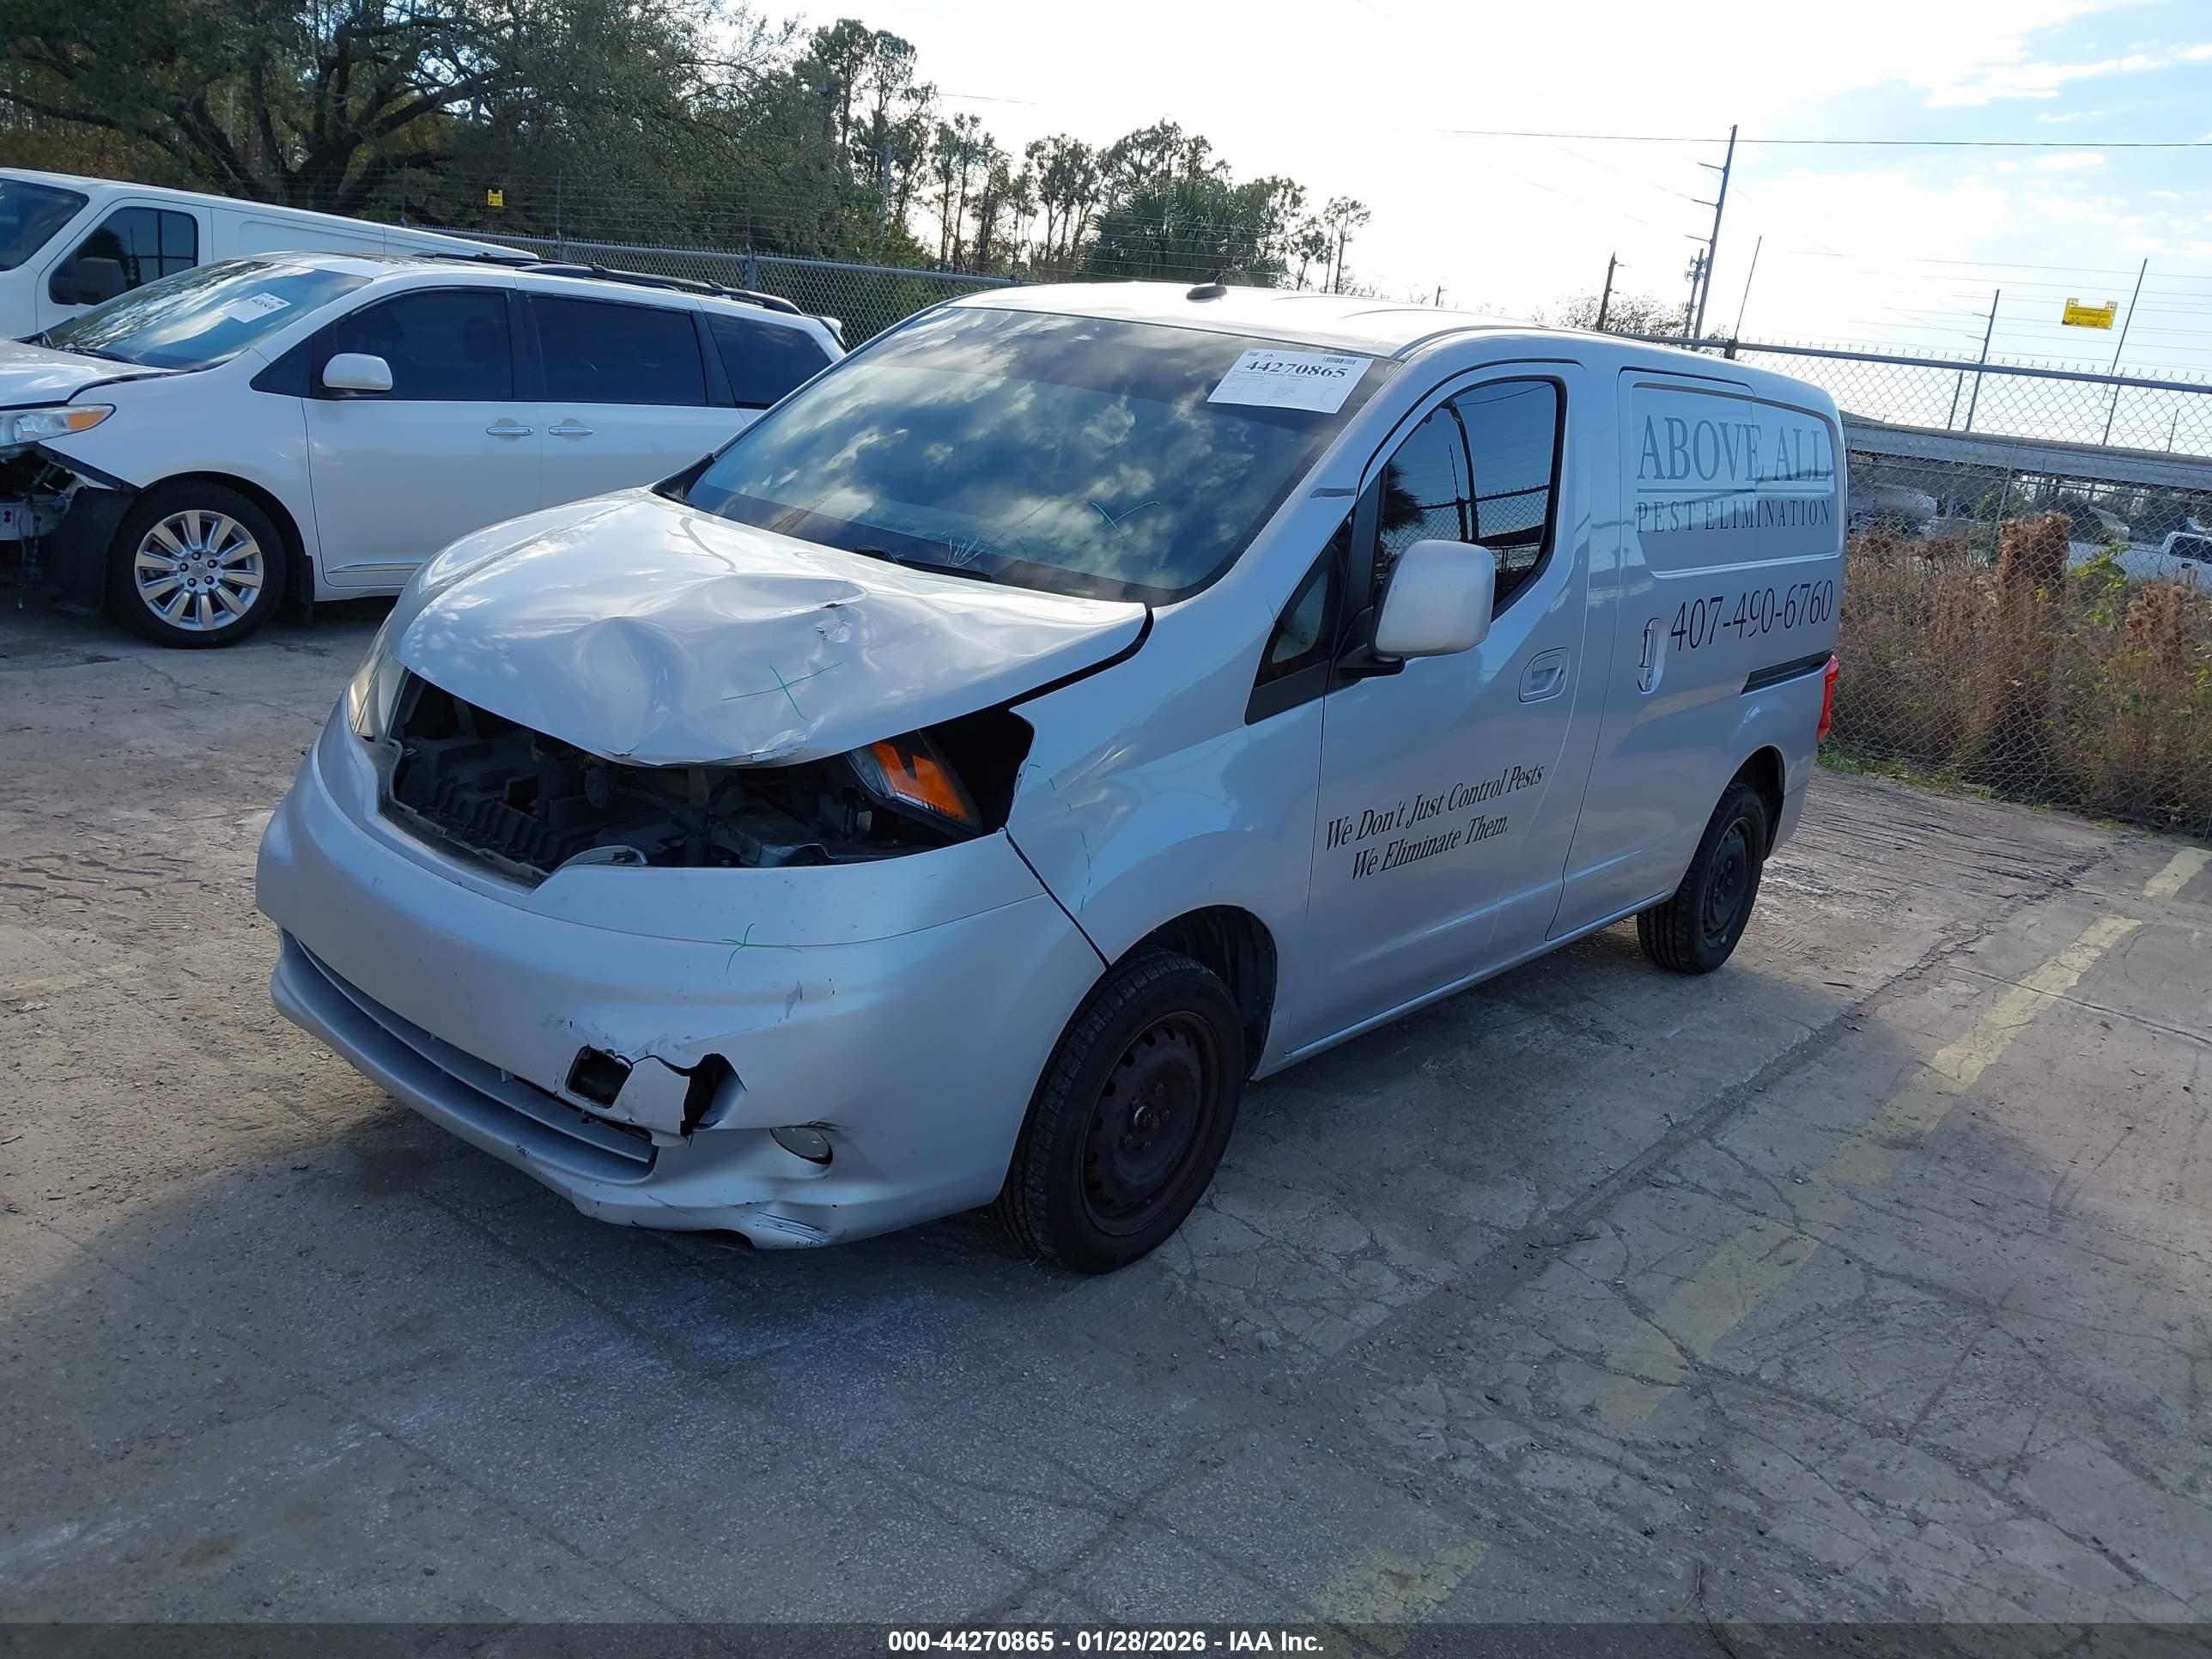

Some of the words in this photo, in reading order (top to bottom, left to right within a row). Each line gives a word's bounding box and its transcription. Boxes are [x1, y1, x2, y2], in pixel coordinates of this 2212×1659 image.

[1245, 361, 1348, 378] 44270865
[1637, 415, 1765, 481] ABOVE
[1774, 426, 1830, 482] ALL
[1637, 501, 1696, 533] PEST
[1704, 499, 1830, 530] ELIMINATION
[1671, 580, 1833, 651] 407-490-6760
[1326, 816, 1352, 851] We
[1356, 800, 1406, 841] Don't
[1406, 789, 1446, 830] Just
[1448, 769, 1509, 811] Control
[1505, 763, 1545, 793] Pests
[1352, 849, 1377, 881] We
[1379, 827, 1462, 872] Eliminate
[1464, 815, 1509, 845] Them.
